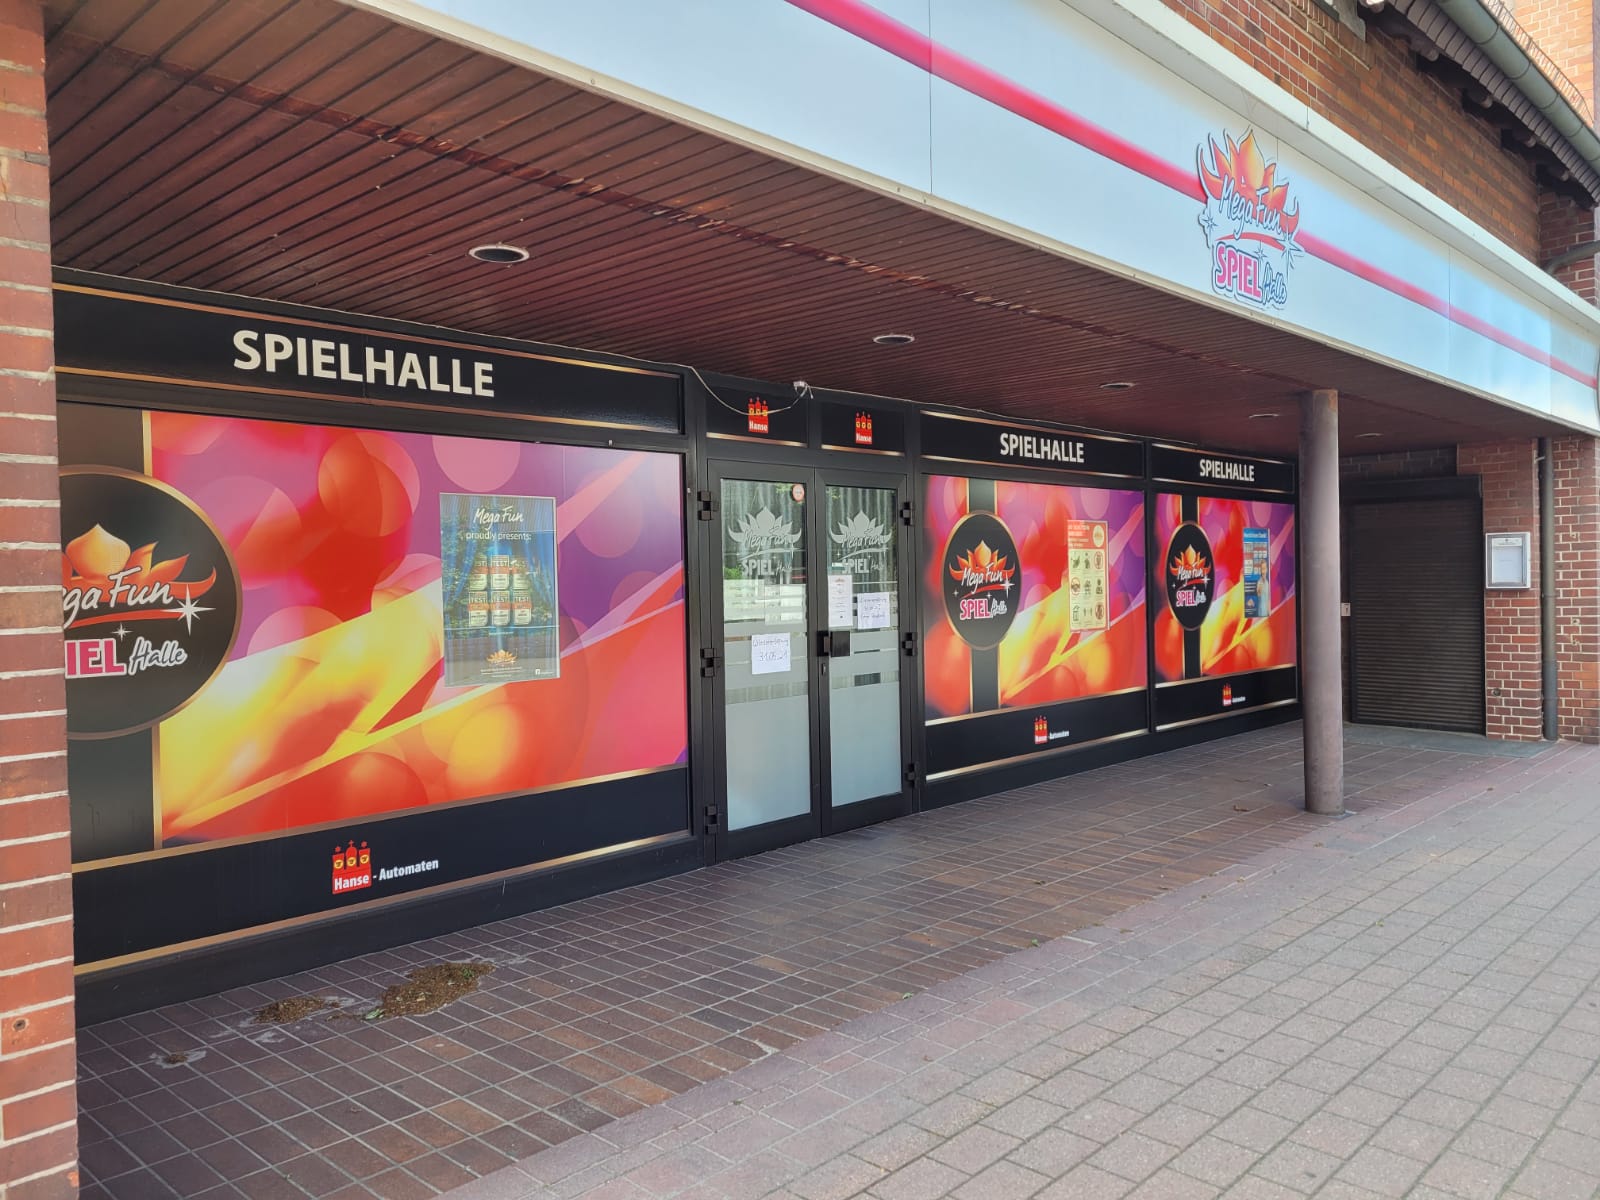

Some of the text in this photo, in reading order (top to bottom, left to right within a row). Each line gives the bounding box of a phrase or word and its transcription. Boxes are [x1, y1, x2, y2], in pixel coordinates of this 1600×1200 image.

[1219, 175, 1284, 239] Mega Fun
[1215, 244, 1262, 299] SPIEL
[232, 330, 495, 398] SPIELHALLE
[748, 420, 768, 432] Hanse
[999, 432, 1085, 463] SPIELHALLE
[1199, 459, 1255, 482] SPIELHALLE
[473, 505, 524, 531] Mega Fun
[465, 531, 532, 542] proudly presents:
[741, 559, 775, 577] SPIEL
[841, 558, 870, 575] SPIEL
[961, 561, 1004, 594] Mega Fun
[63, 566, 174, 629] ga Fun
[960, 598, 991, 620] SPIEL
[1176, 590, 1196, 607] SPIEL
[65, 637, 188, 679] IEL Halle
[334, 874, 370, 891] Hanse
